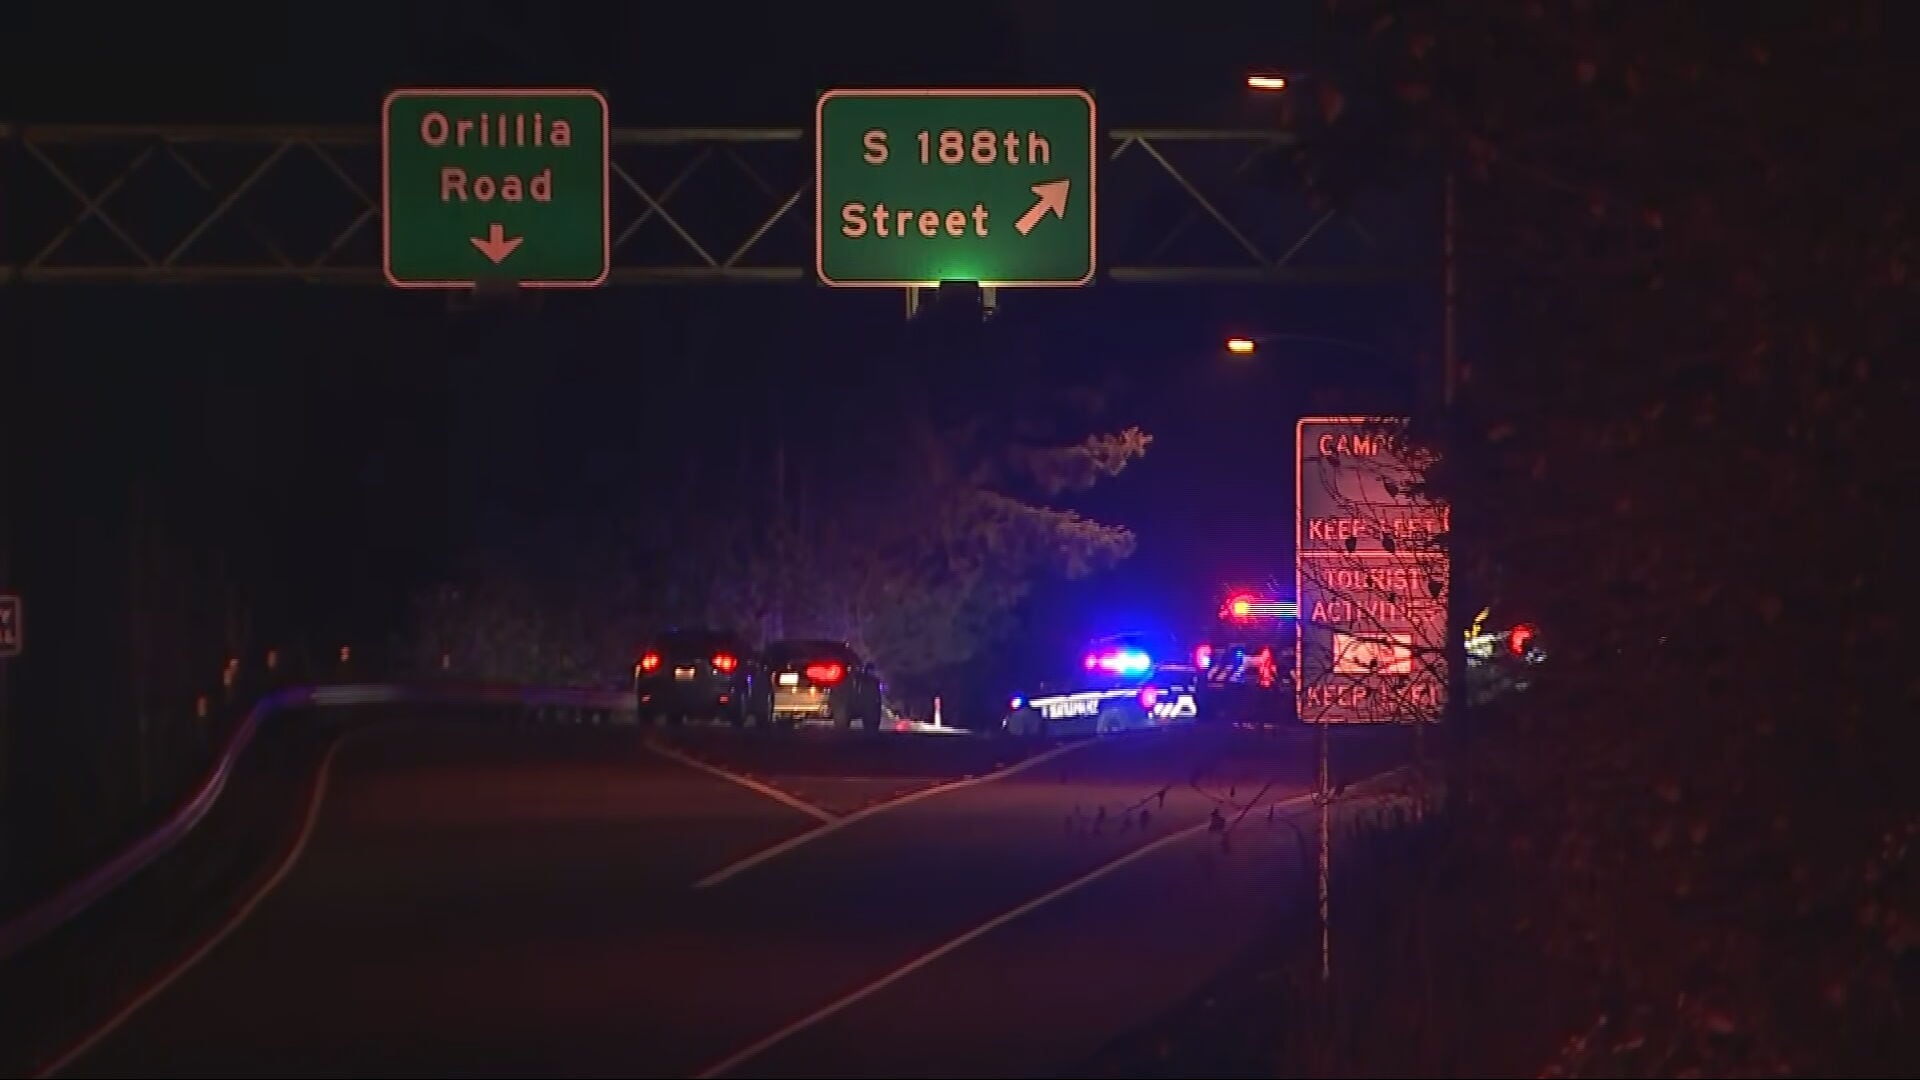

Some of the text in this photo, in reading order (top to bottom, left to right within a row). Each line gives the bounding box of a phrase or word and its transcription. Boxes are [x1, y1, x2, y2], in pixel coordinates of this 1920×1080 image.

[420, 112, 572, 147] Orillia
[862, 130, 1051, 165] S 188th
[440, 167, 553, 202] Road
[841, 202, 989, 238] Street
[1308, 518, 1366, 540] KEEP
[1324, 568, 1422, 591] TOURIST
[1307, 684, 1368, 707] KEEP
